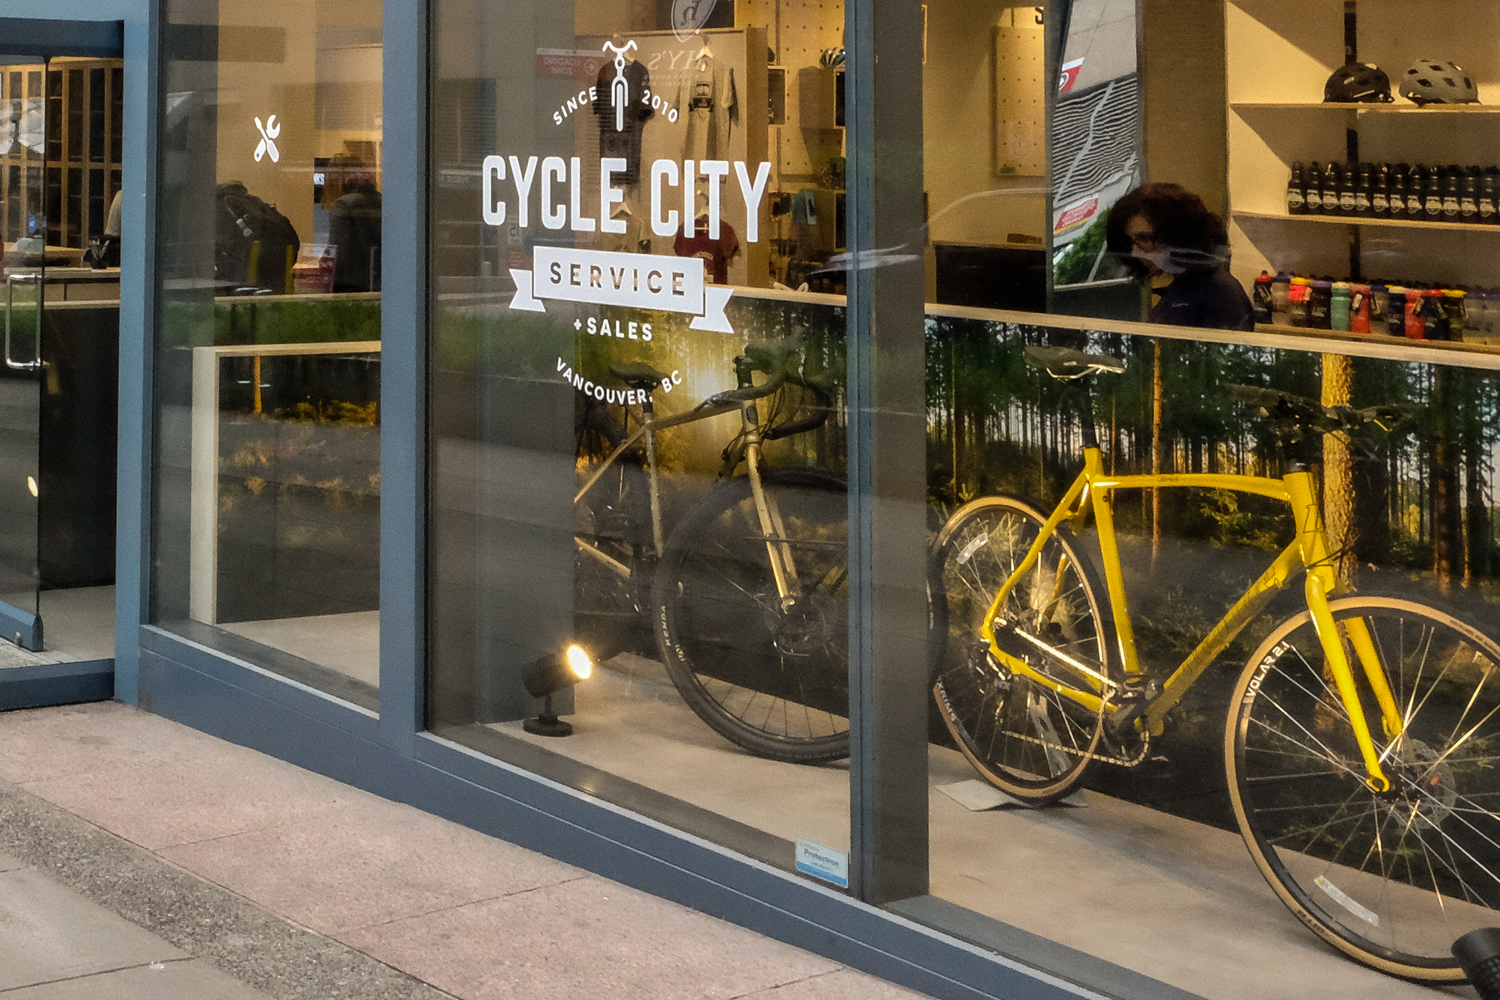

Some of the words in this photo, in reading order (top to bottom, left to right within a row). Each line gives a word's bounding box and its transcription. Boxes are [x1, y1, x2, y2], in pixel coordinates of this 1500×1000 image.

[553, 86, 598, 126] SINCE
[641, 89, 679, 124] 2010
[481, 154, 628, 235] CYCLE
[650, 158, 772, 243] CITY
[549, 261, 687, 297] SERVICE
[661, 369, 683, 394] BC
[660, 605, 671, 647] KENDA
[1245, 655, 1276, 697] VOLAR
